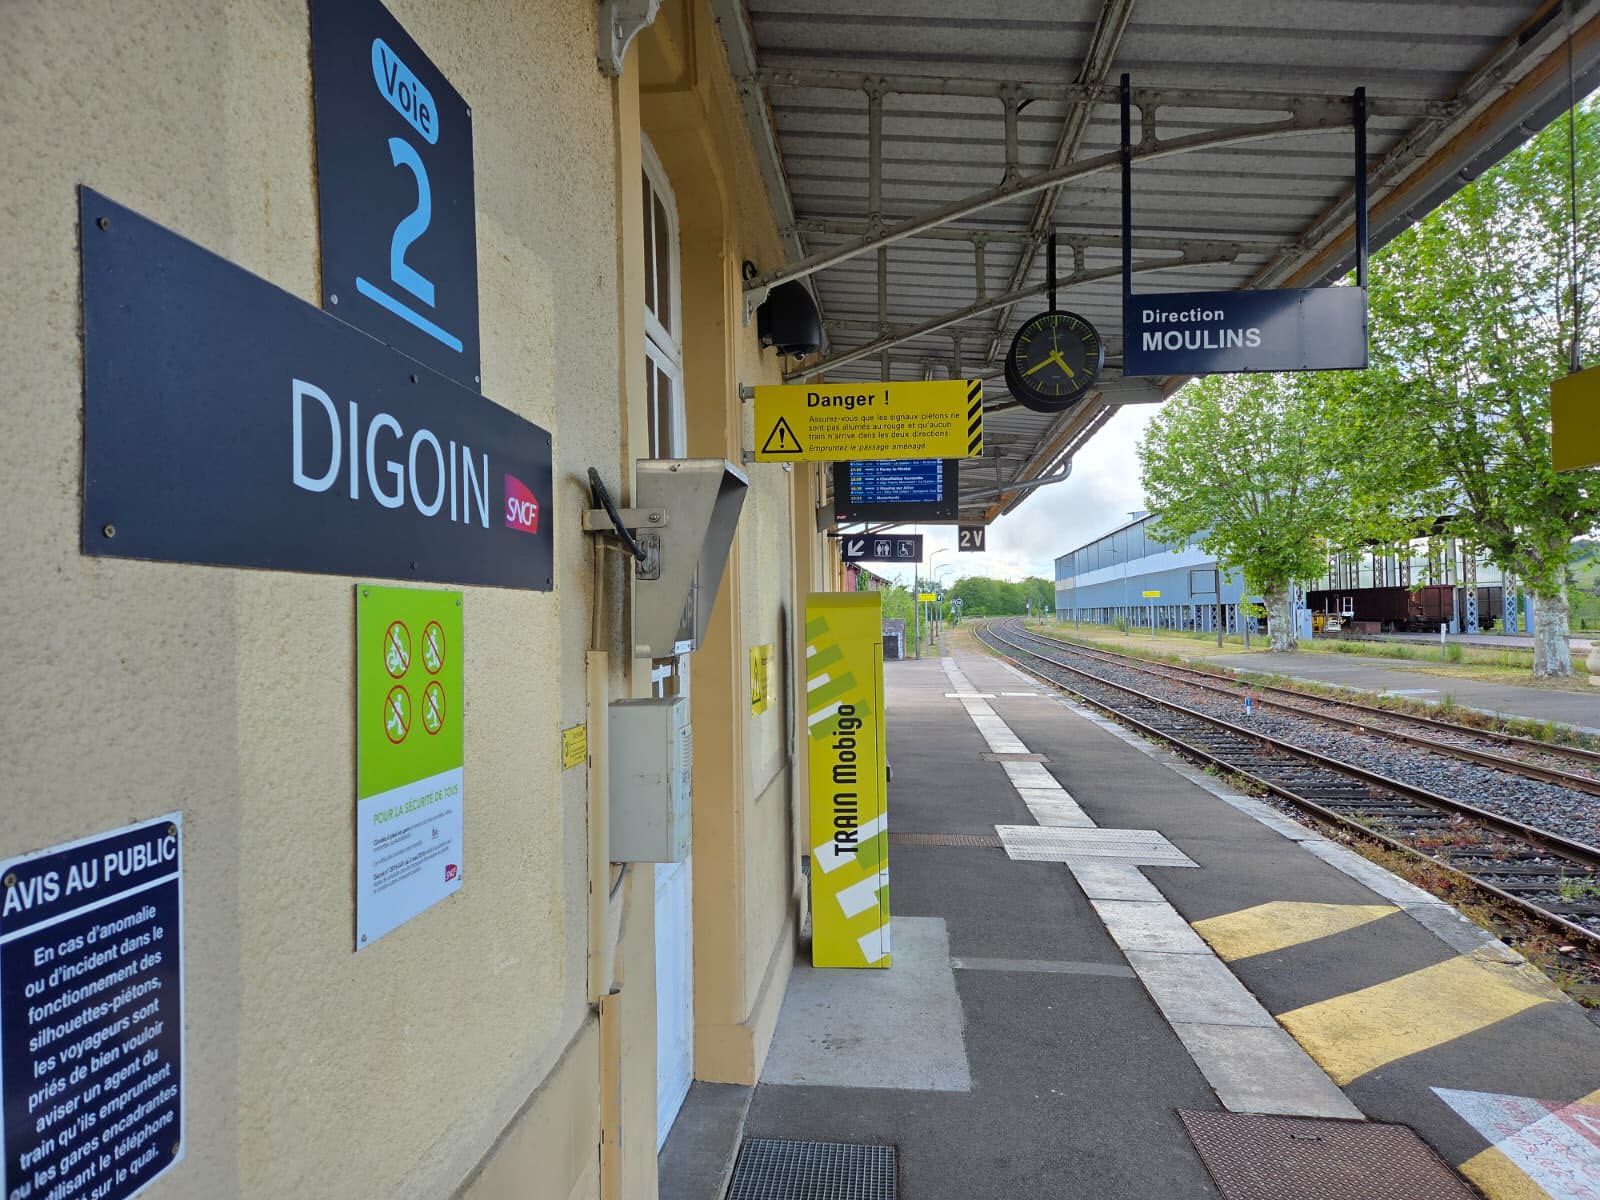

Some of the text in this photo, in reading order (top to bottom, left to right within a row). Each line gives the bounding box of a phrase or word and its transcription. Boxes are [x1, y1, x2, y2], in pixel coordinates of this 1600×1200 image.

[380, 47, 431, 134] Voie
[388, 137, 436, 309] 2
[1142, 308, 1225, 324] Direction
[1142, 328, 1262, 351] MOULINS
[807, 391, 875, 410] Danger
[826, 425, 840, 433] pas
[861, 415, 874, 423] que
[890, 414, 918, 423] signaux
[292, 378, 490, 529] DIGOIN
[506, 497, 537, 526] SNCF
[373, 808, 394, 826] POUR
[394, 805, 404, 817] LA
[434, 790, 443, 802] DE
[832, 704, 863, 857] TRAIN Mobigo
[2, 836, 176, 917] AVIS AU PUBLIC
[25, 926, 164, 998] ou d'incident dans le
[34, 905, 157, 967] En cas d'anomalie
[28, 951, 162, 1025] fonctionnement des
[29, 976, 162, 1052] silhouettes-piétons,
[28, 1021, 164, 1113] priés de bien vouloir
[34, 998, 160, 1078] les voyageurs sont
[19, 1062, 171, 1171] train qu'ils empruntent
[35, 1049, 159, 1133] aviser un agent du
[9, 1084, 178, 1200] ou les gares encadrantes
[44, 1110, 174, 1200] tilisant le téléphone
[90, 1143, 160, 1200] sur le quai.
